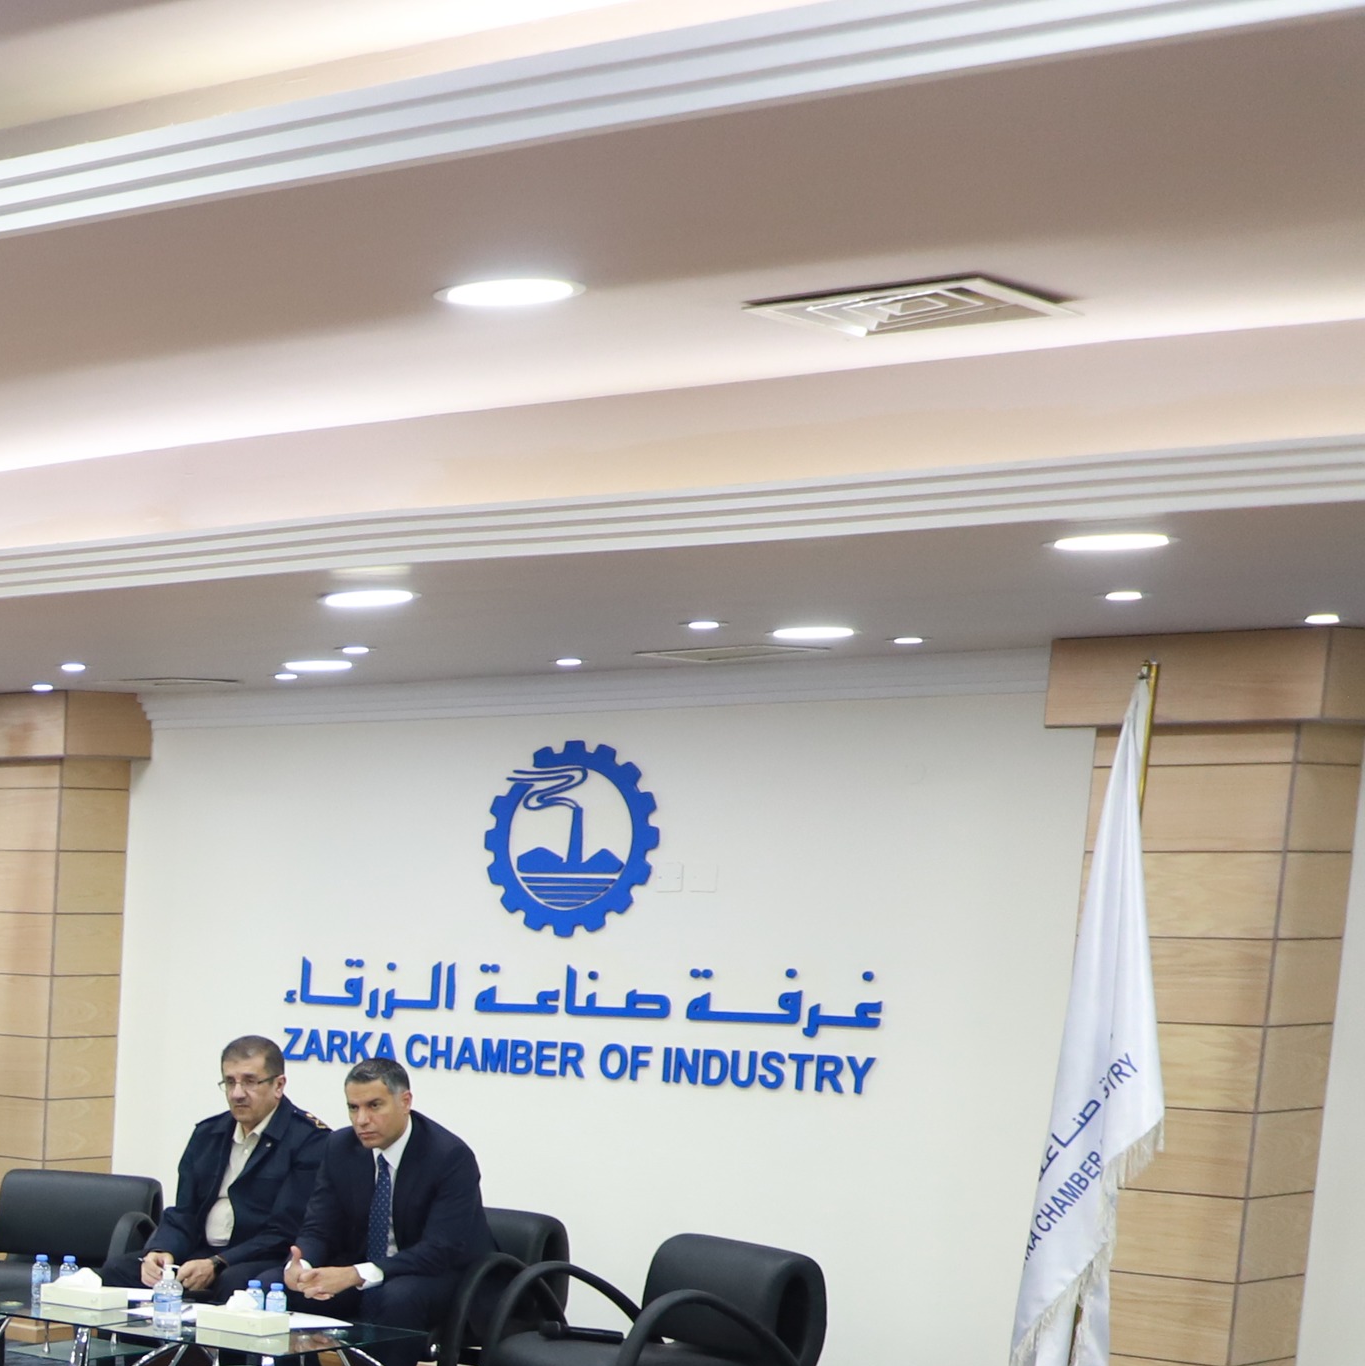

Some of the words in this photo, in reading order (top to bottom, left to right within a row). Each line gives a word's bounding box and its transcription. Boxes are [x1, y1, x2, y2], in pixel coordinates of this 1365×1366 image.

[284, 956, 456, 1019] الزرقاء
[474, 963, 671, 1019] صناعة
[686, 968, 883, 1038] غرفة
[283, 1027, 397, 1064] ZARKA
[405, 1033, 585, 1079] CHAMBER
[599, 1043, 653, 1081] OF
[662, 1046, 877, 1095] INDUSTRY
